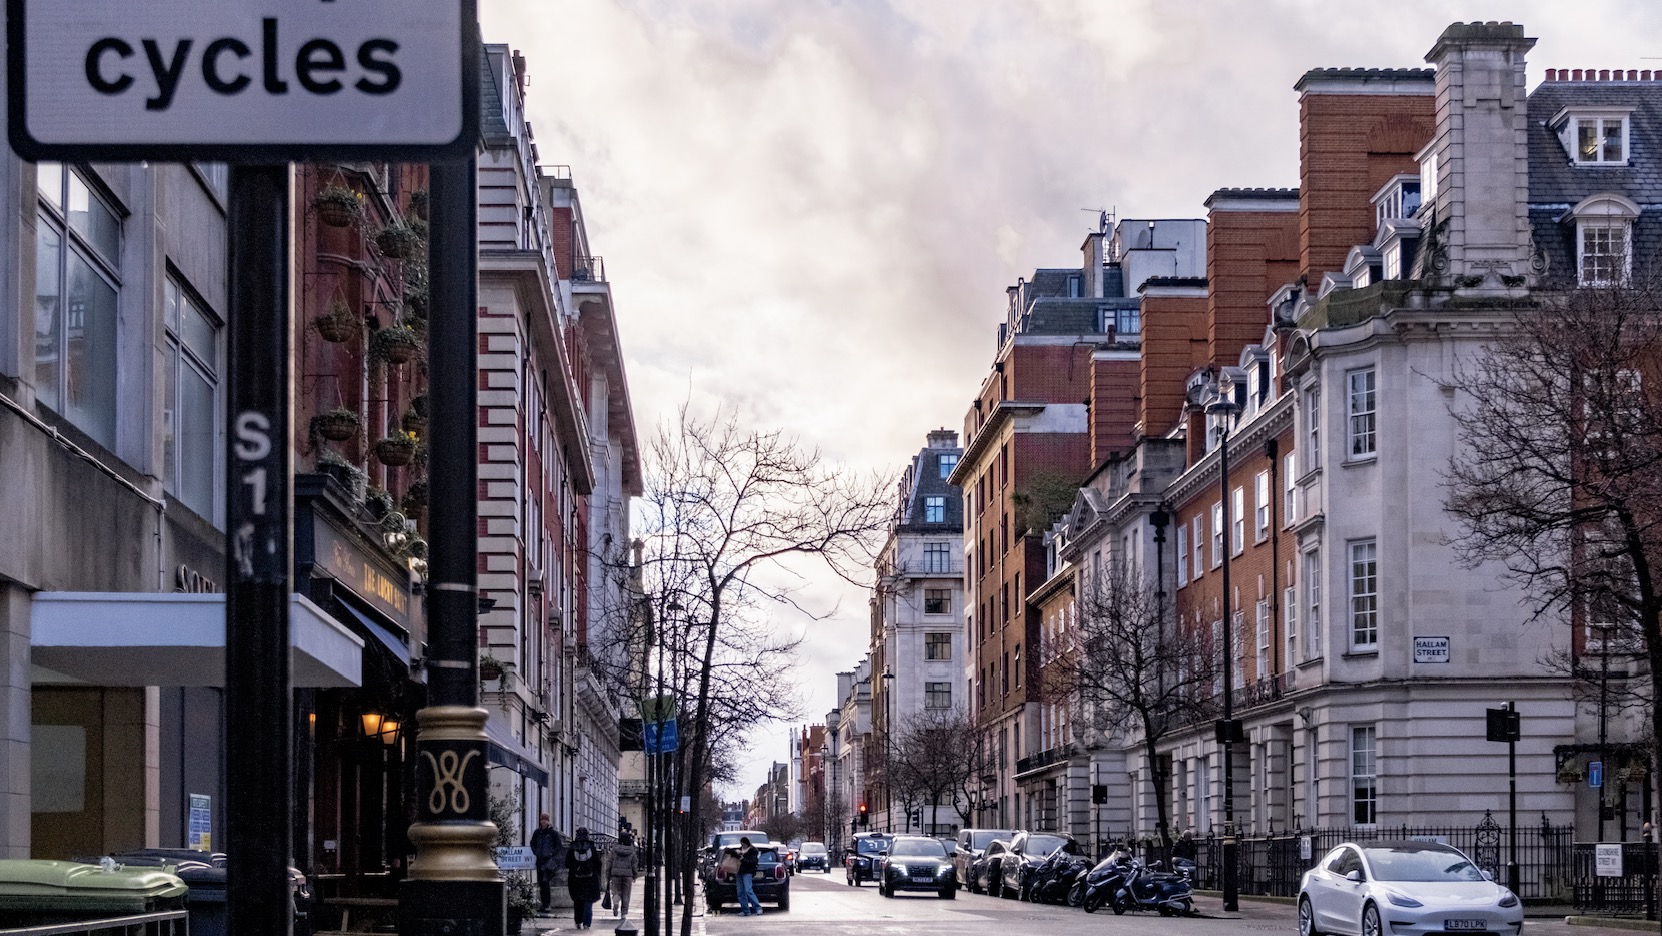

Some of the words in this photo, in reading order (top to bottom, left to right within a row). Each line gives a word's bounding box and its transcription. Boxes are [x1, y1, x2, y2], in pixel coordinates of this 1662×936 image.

[84, 17, 403, 111] cycles
[364, 562, 376, 592] THE
[1449, 920, 1469, 928] LB70
[1470, 920, 1485, 928] LPK
